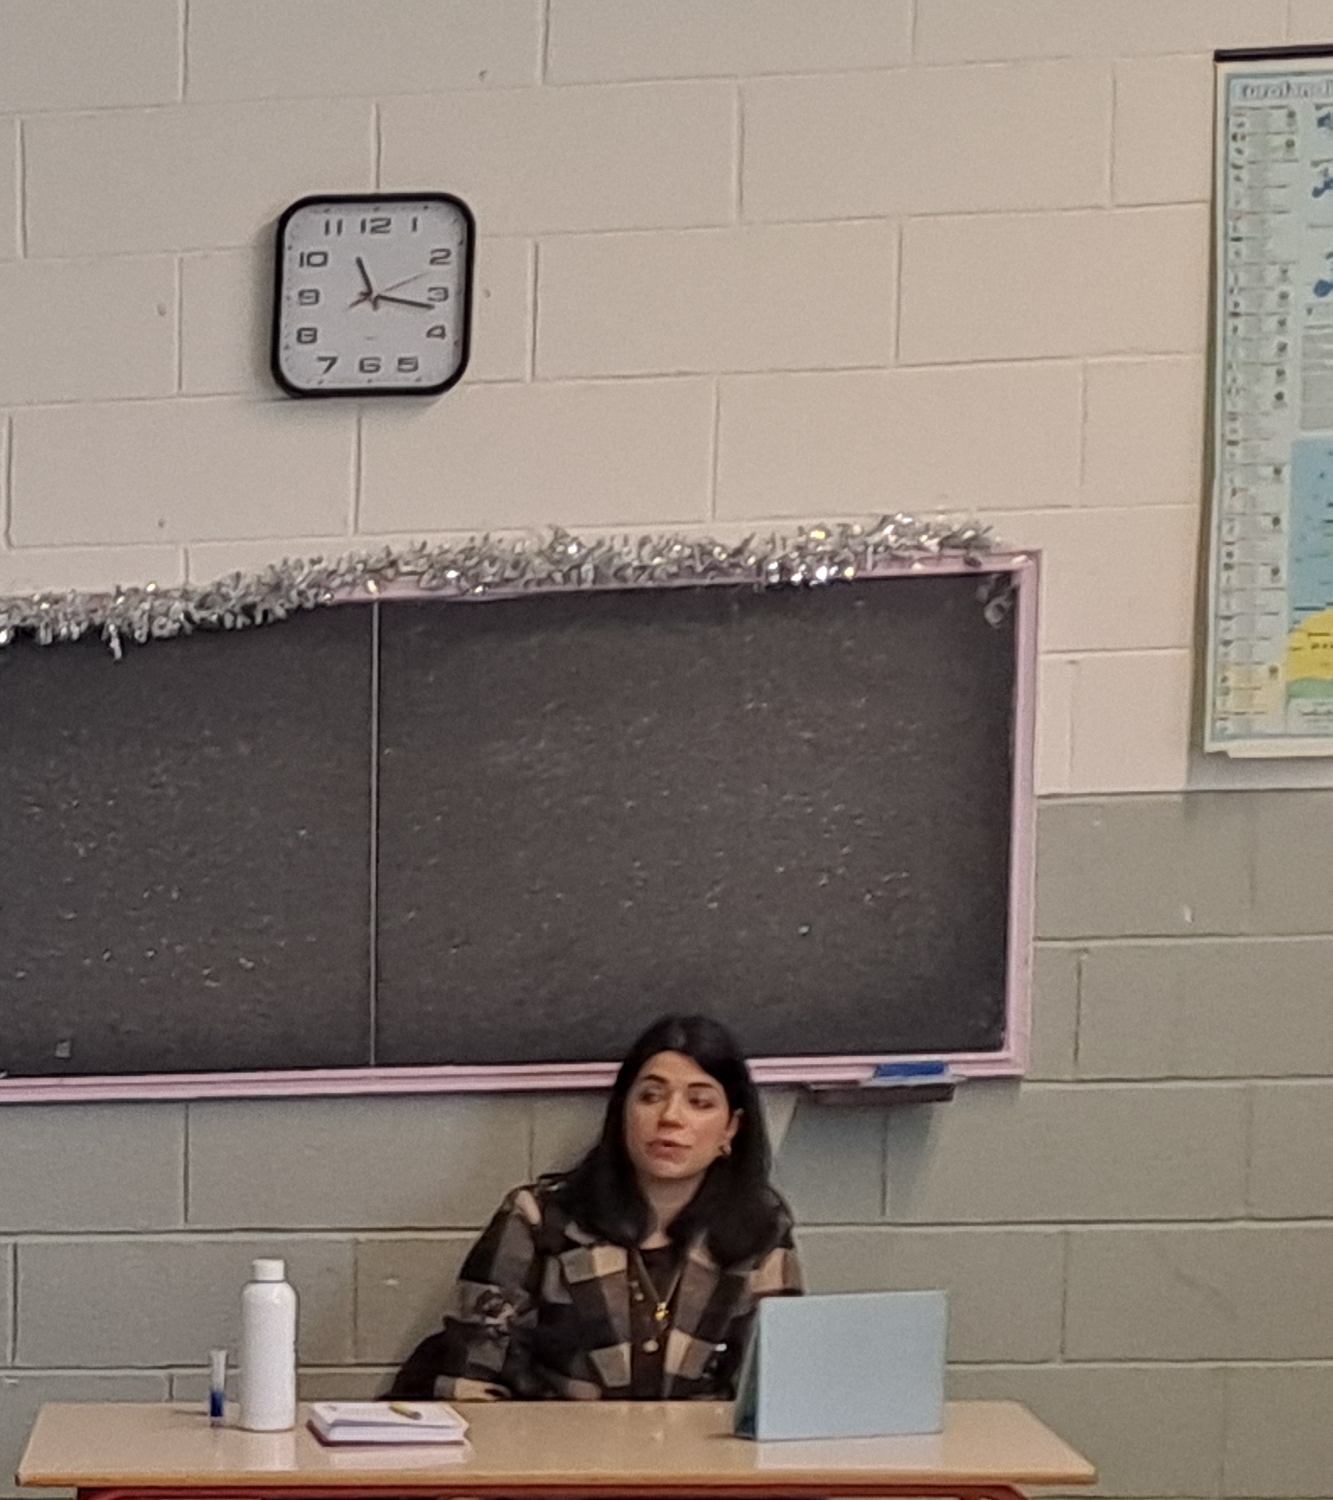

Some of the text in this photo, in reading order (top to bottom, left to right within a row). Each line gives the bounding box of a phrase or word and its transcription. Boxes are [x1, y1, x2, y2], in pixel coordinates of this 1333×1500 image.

[324, 218, 343, 236] 11
[360, 217, 391, 234] 12
[410, 216, 419, 232] 1
[299, 251, 328, 268] 10
[429, 248, 452, 265] 2
[298, 288, 320, 306] 9
[427, 286, 449, 302] 3
[296, 327, 318, 344] 8
[426, 324, 446, 340] 4
[317, 356, 338, 375] 7
[359, 357, 381, 374] 6
[397, 357, 419, 373] 5
